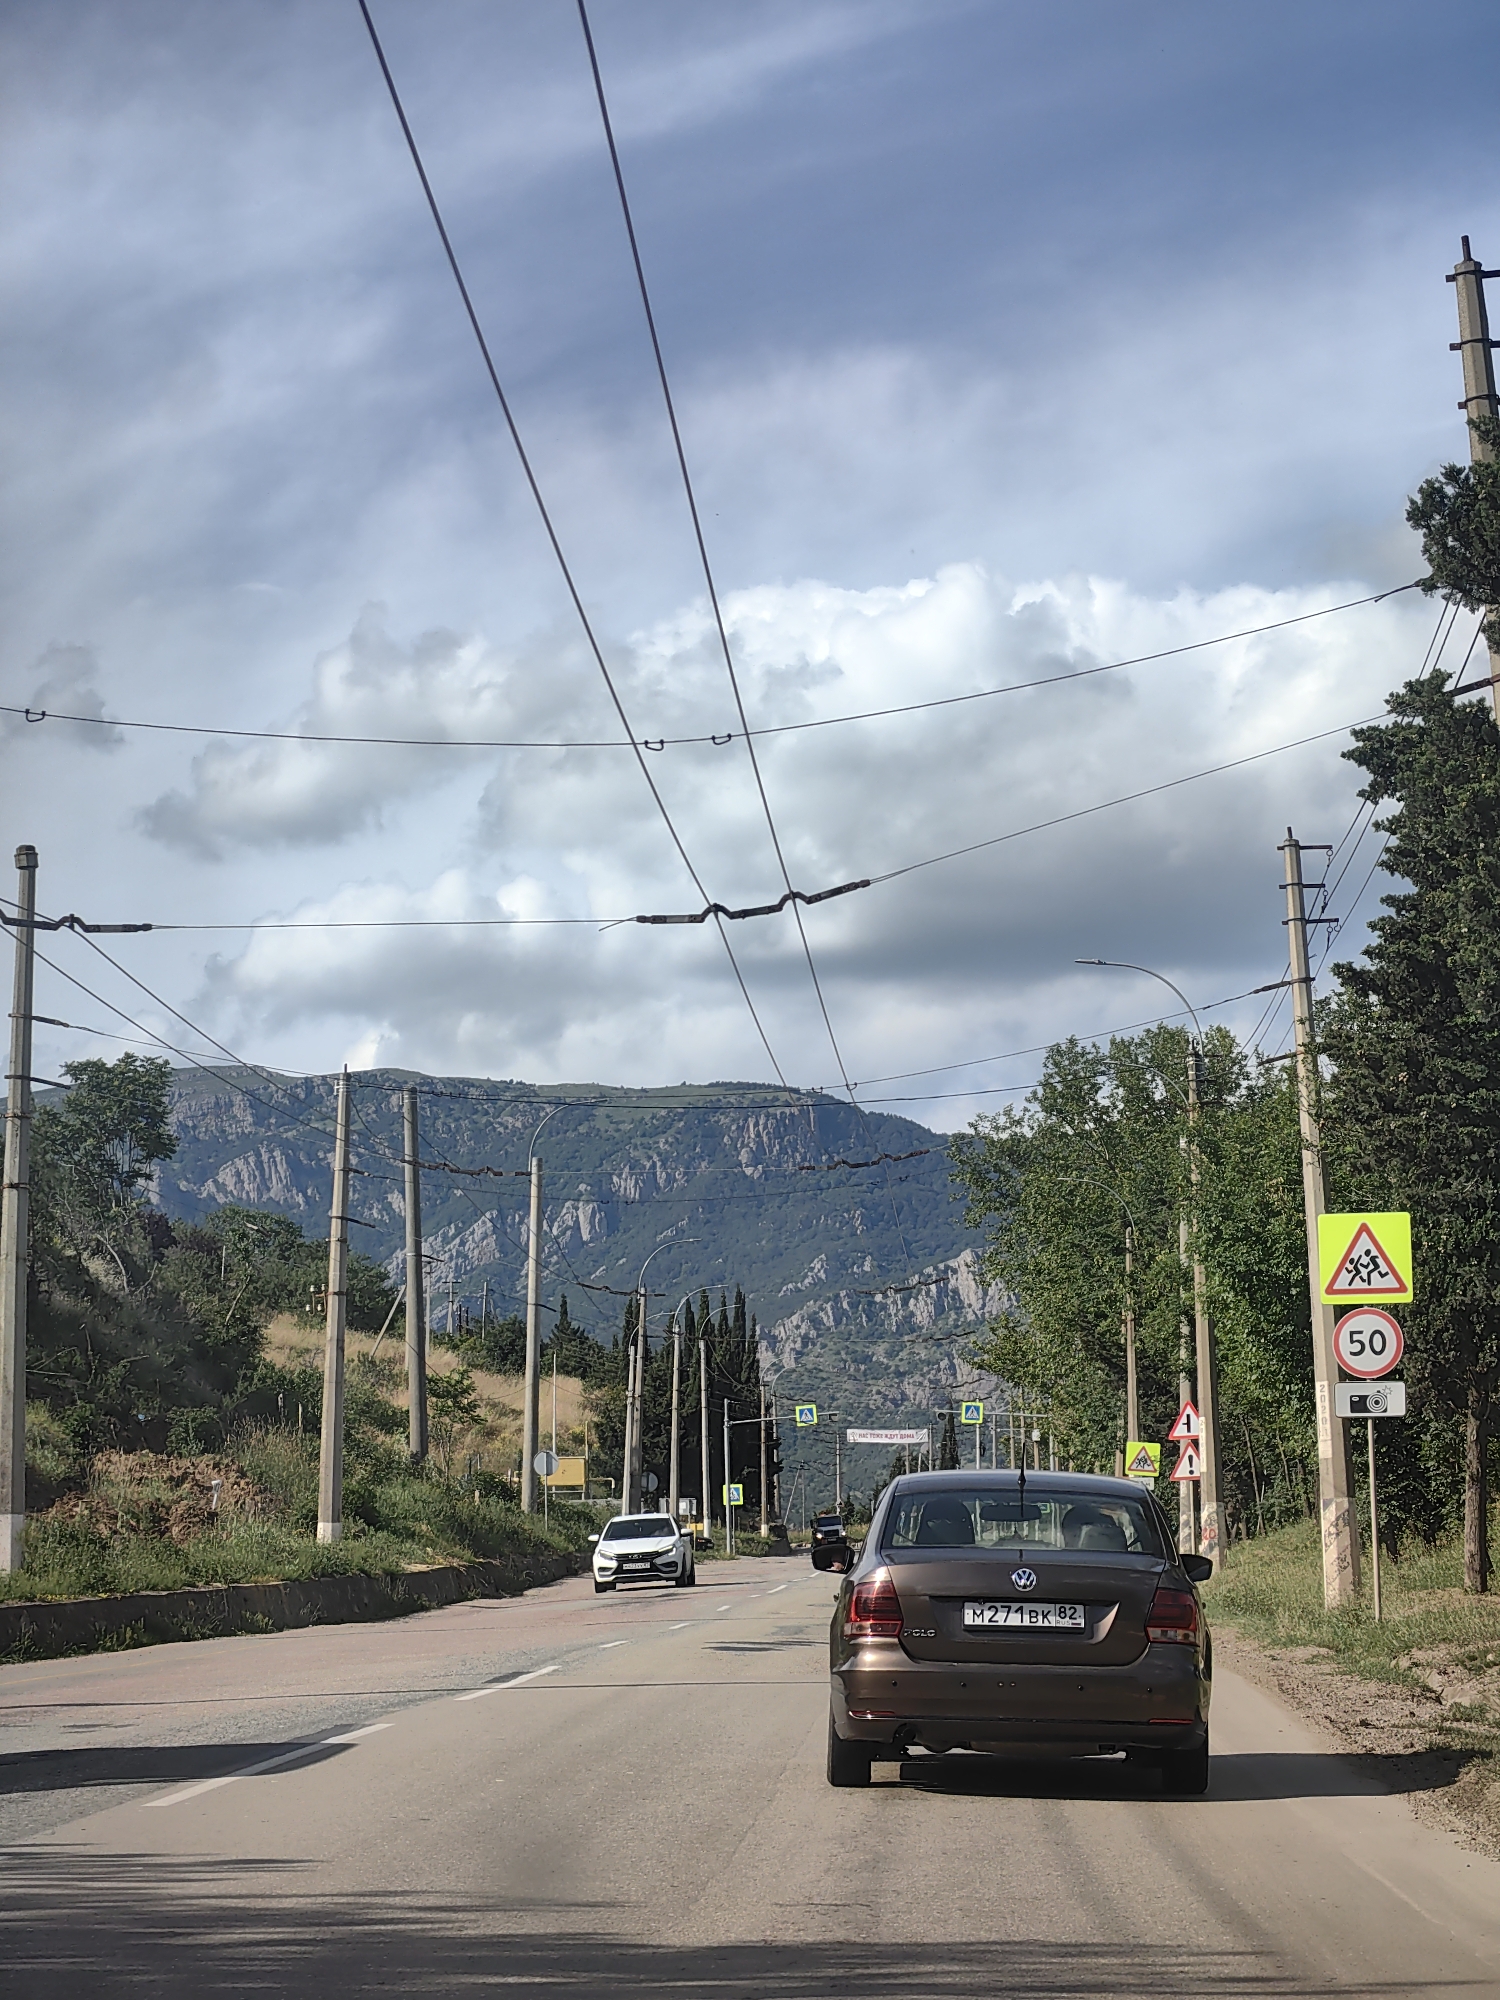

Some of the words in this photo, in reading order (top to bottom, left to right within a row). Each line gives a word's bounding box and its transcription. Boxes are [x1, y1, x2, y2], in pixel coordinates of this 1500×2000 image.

[1349, 1329, 1387, 1357] 50
[1058, 1606, 1078, 1620] 82
[903, 1628, 936, 1637] POLO
